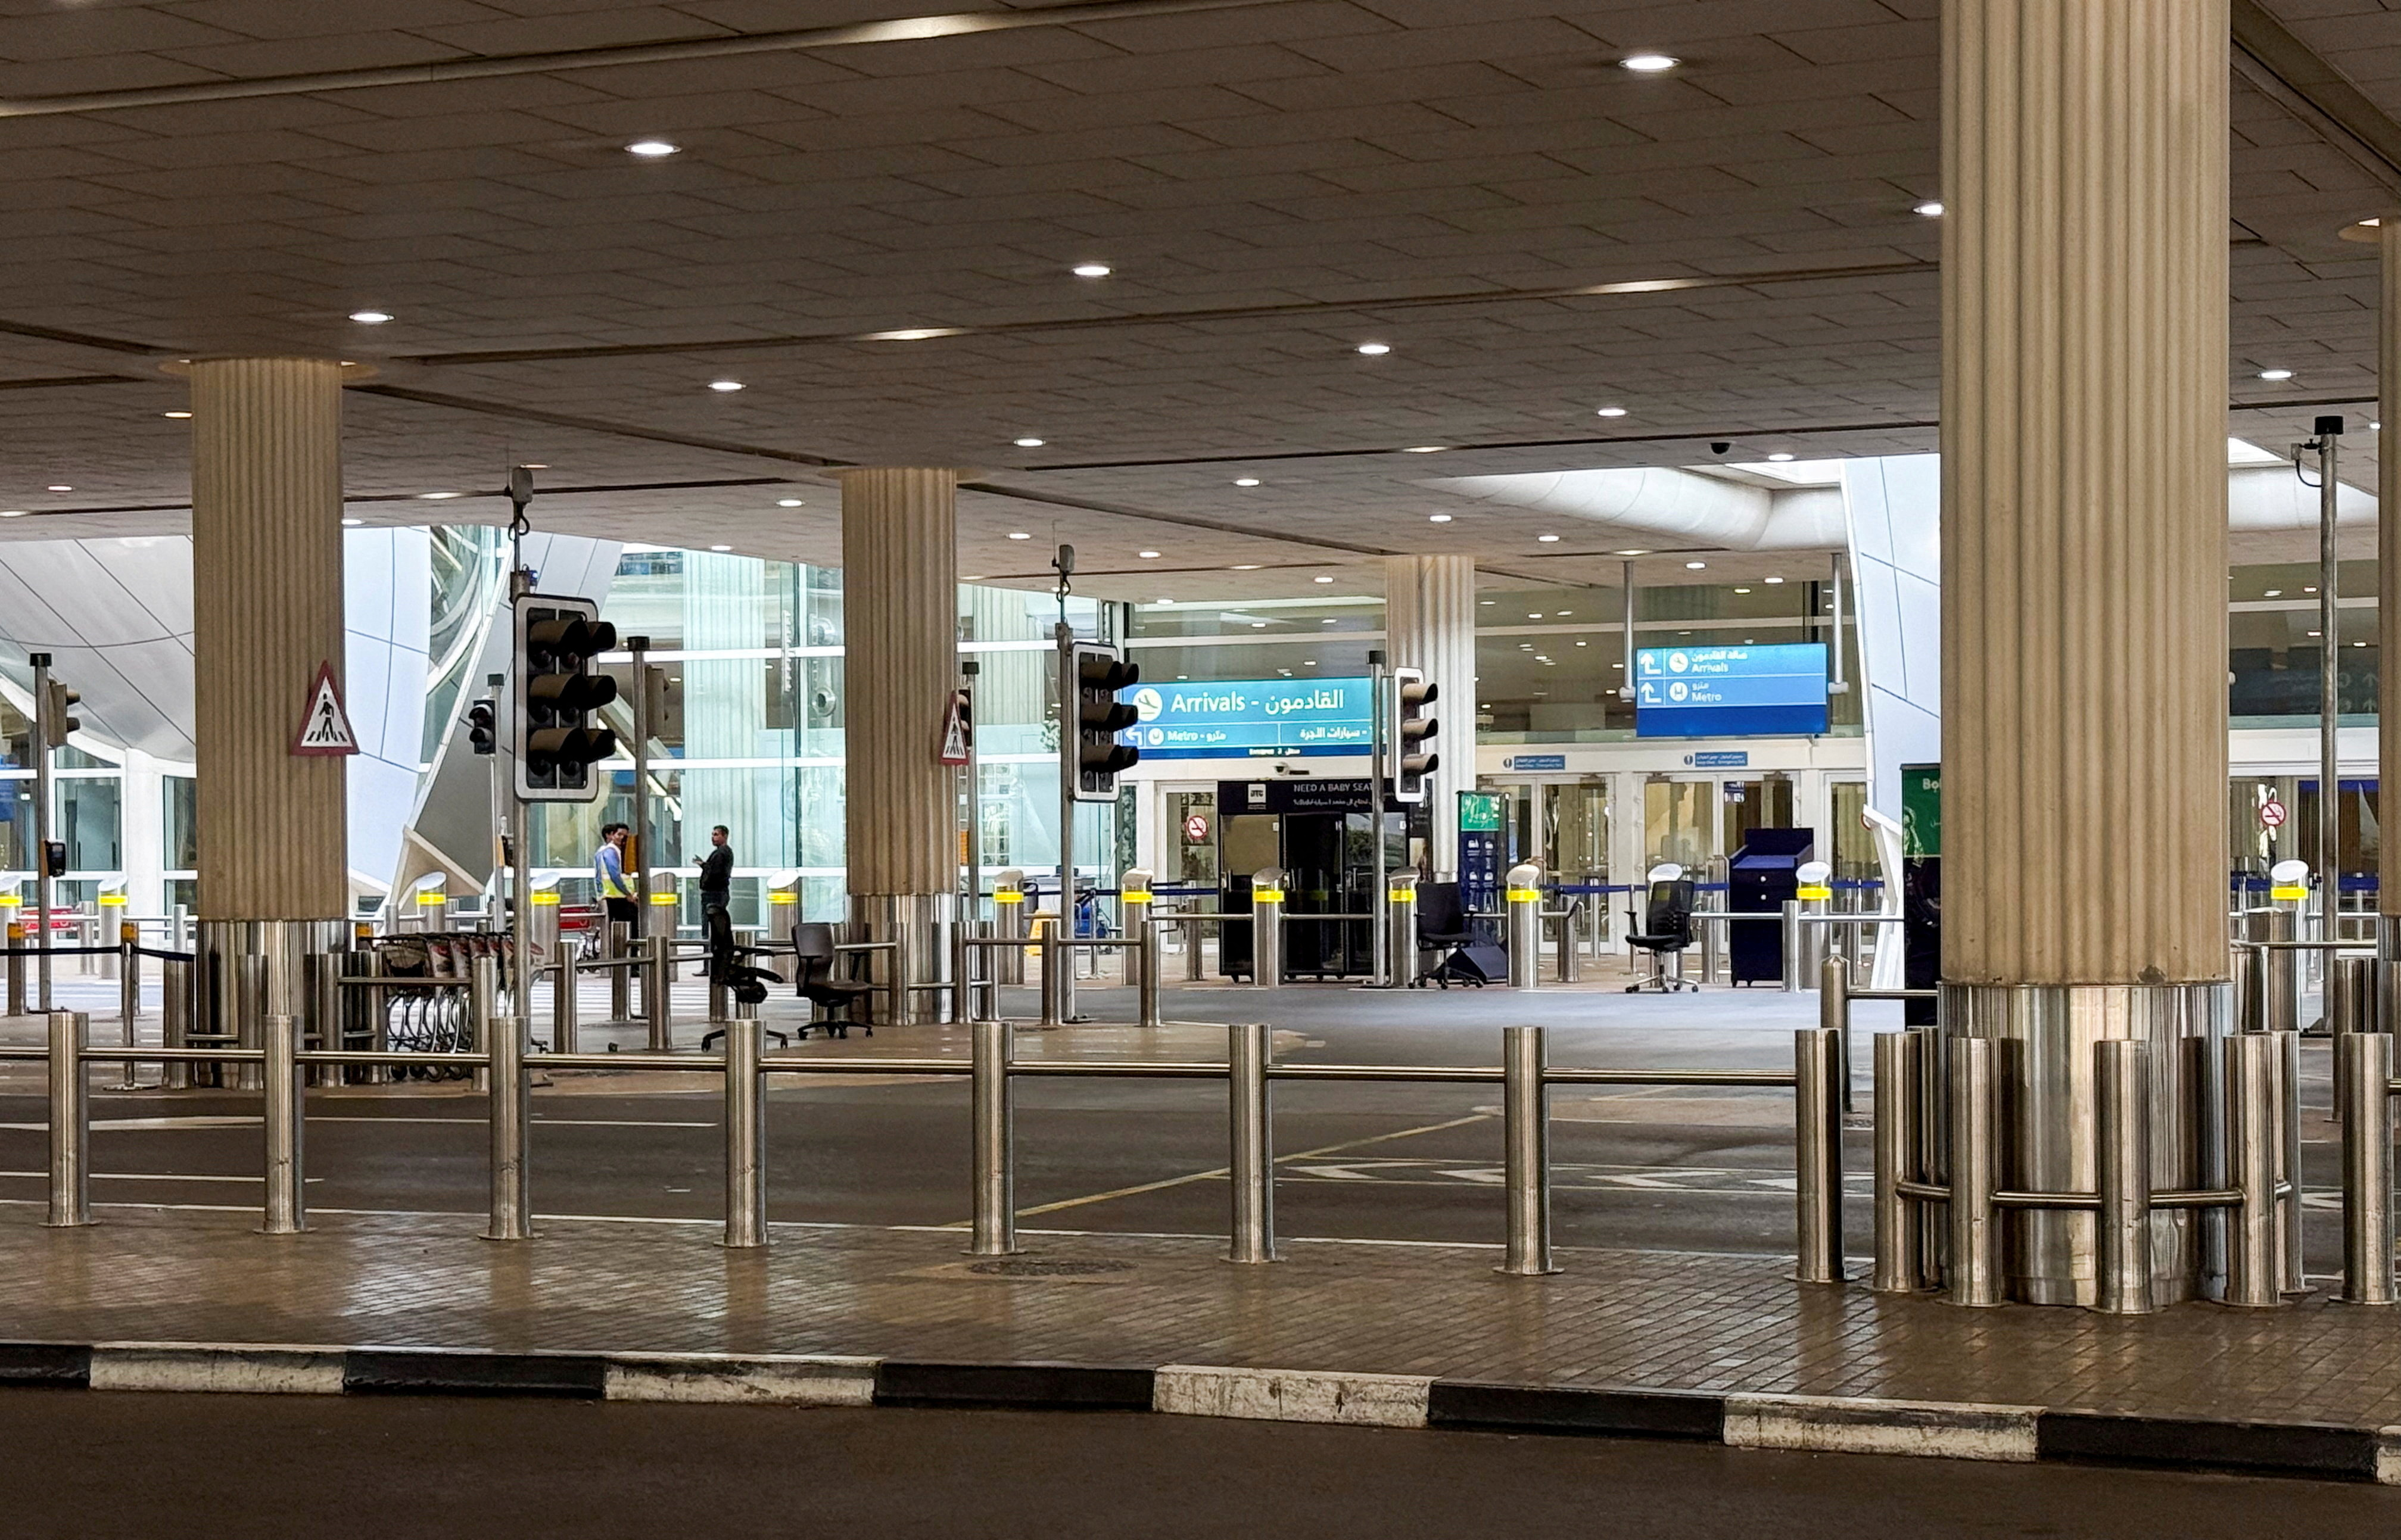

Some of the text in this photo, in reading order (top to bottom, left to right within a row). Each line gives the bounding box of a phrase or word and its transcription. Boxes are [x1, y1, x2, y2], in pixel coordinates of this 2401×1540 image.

[1691, 663, 1729, 673] Arrivals
[1170, 690, 1245, 713] Arrivals
[1265, 689, 1344, 715] القادمون
[1692, 692, 1722, 702] Metro
[1167, 730, 1198, 741] Metro
[1326, 726, 1361, 740] سيارات
[1319, 783, 1326, 792] A
[1328, 783, 1350, 792] BABY
[1923, 778, 1941, 793] Bo
